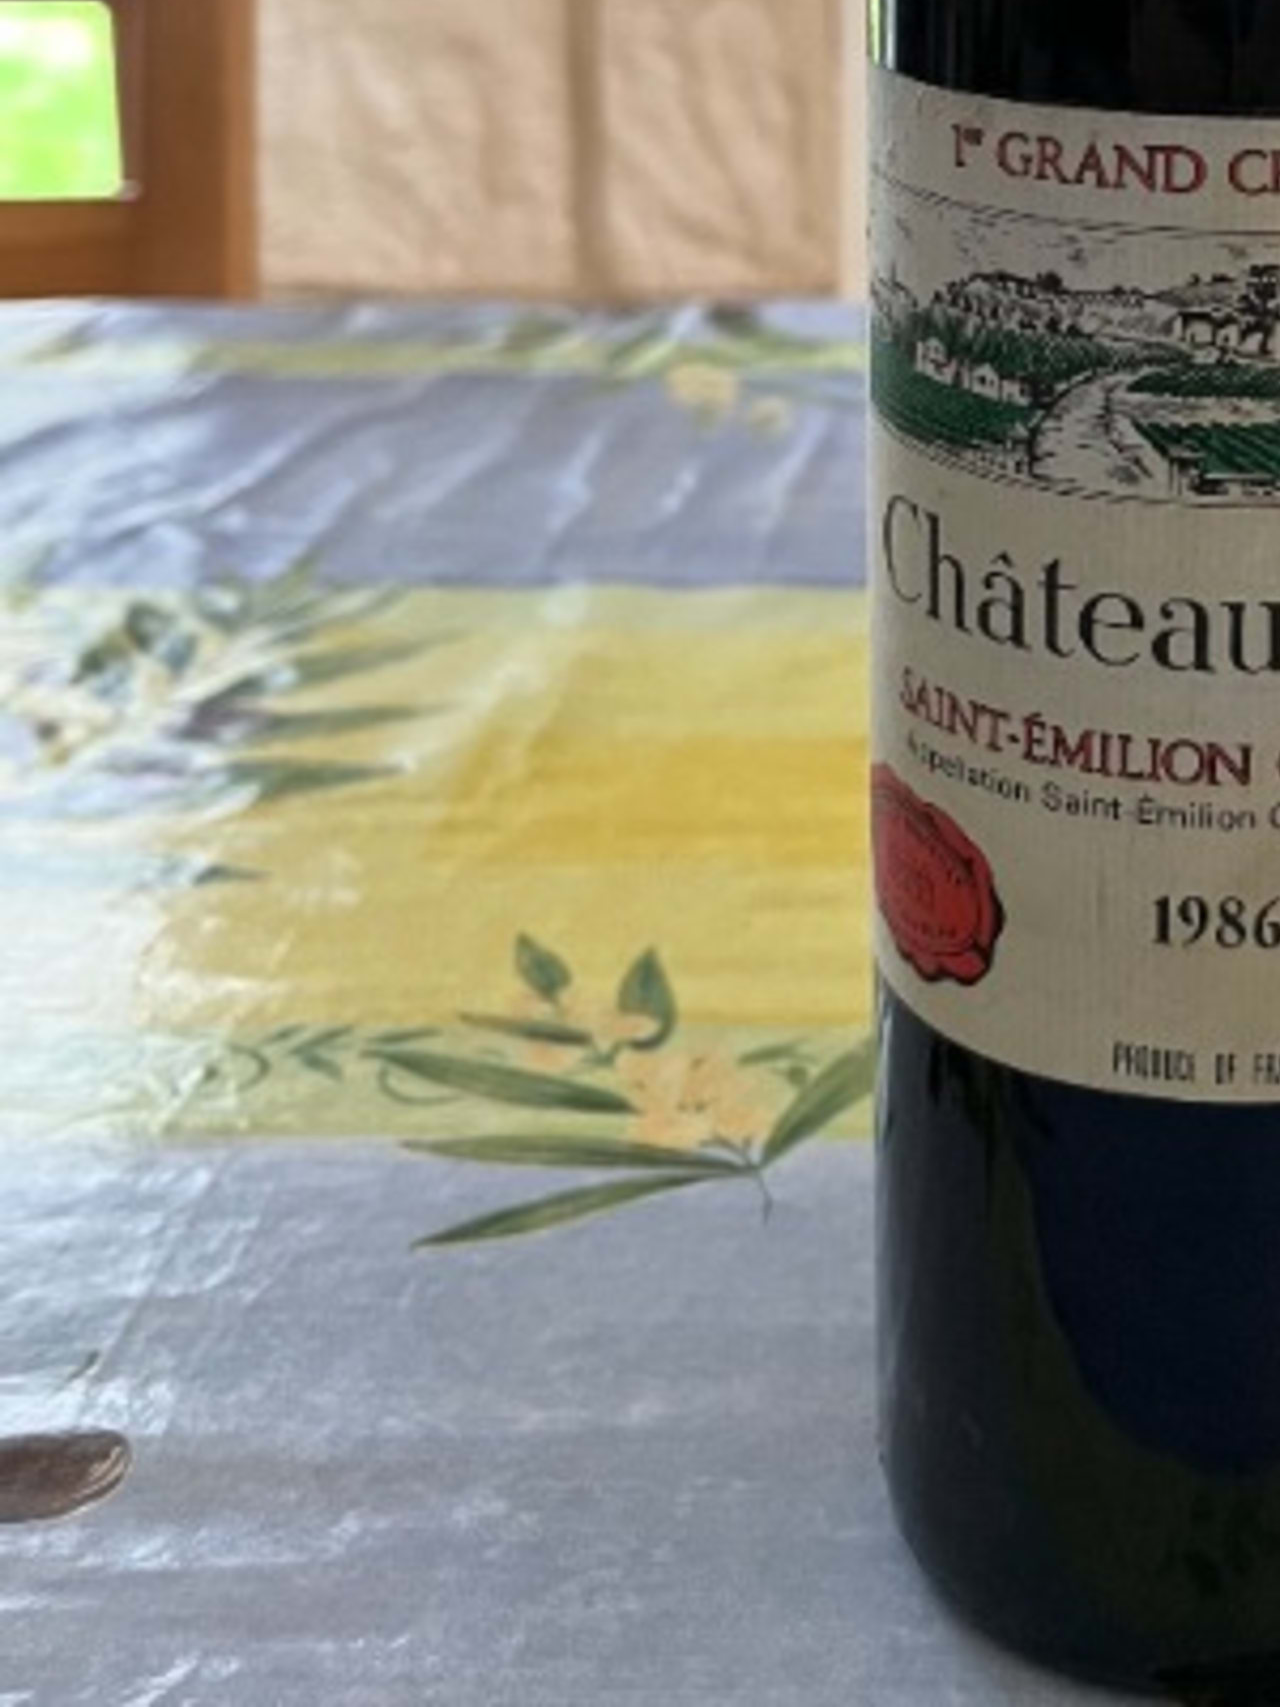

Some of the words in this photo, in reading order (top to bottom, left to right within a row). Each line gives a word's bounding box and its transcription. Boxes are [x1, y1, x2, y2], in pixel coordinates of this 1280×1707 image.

[996, 131, 1208, 194] GRAND
[899, 666, 1253, 787] SAINT-ÉMILION
[1113, 1041, 1196, 1084] PRODUCE
[1215, 1052, 1237, 1085] OF
